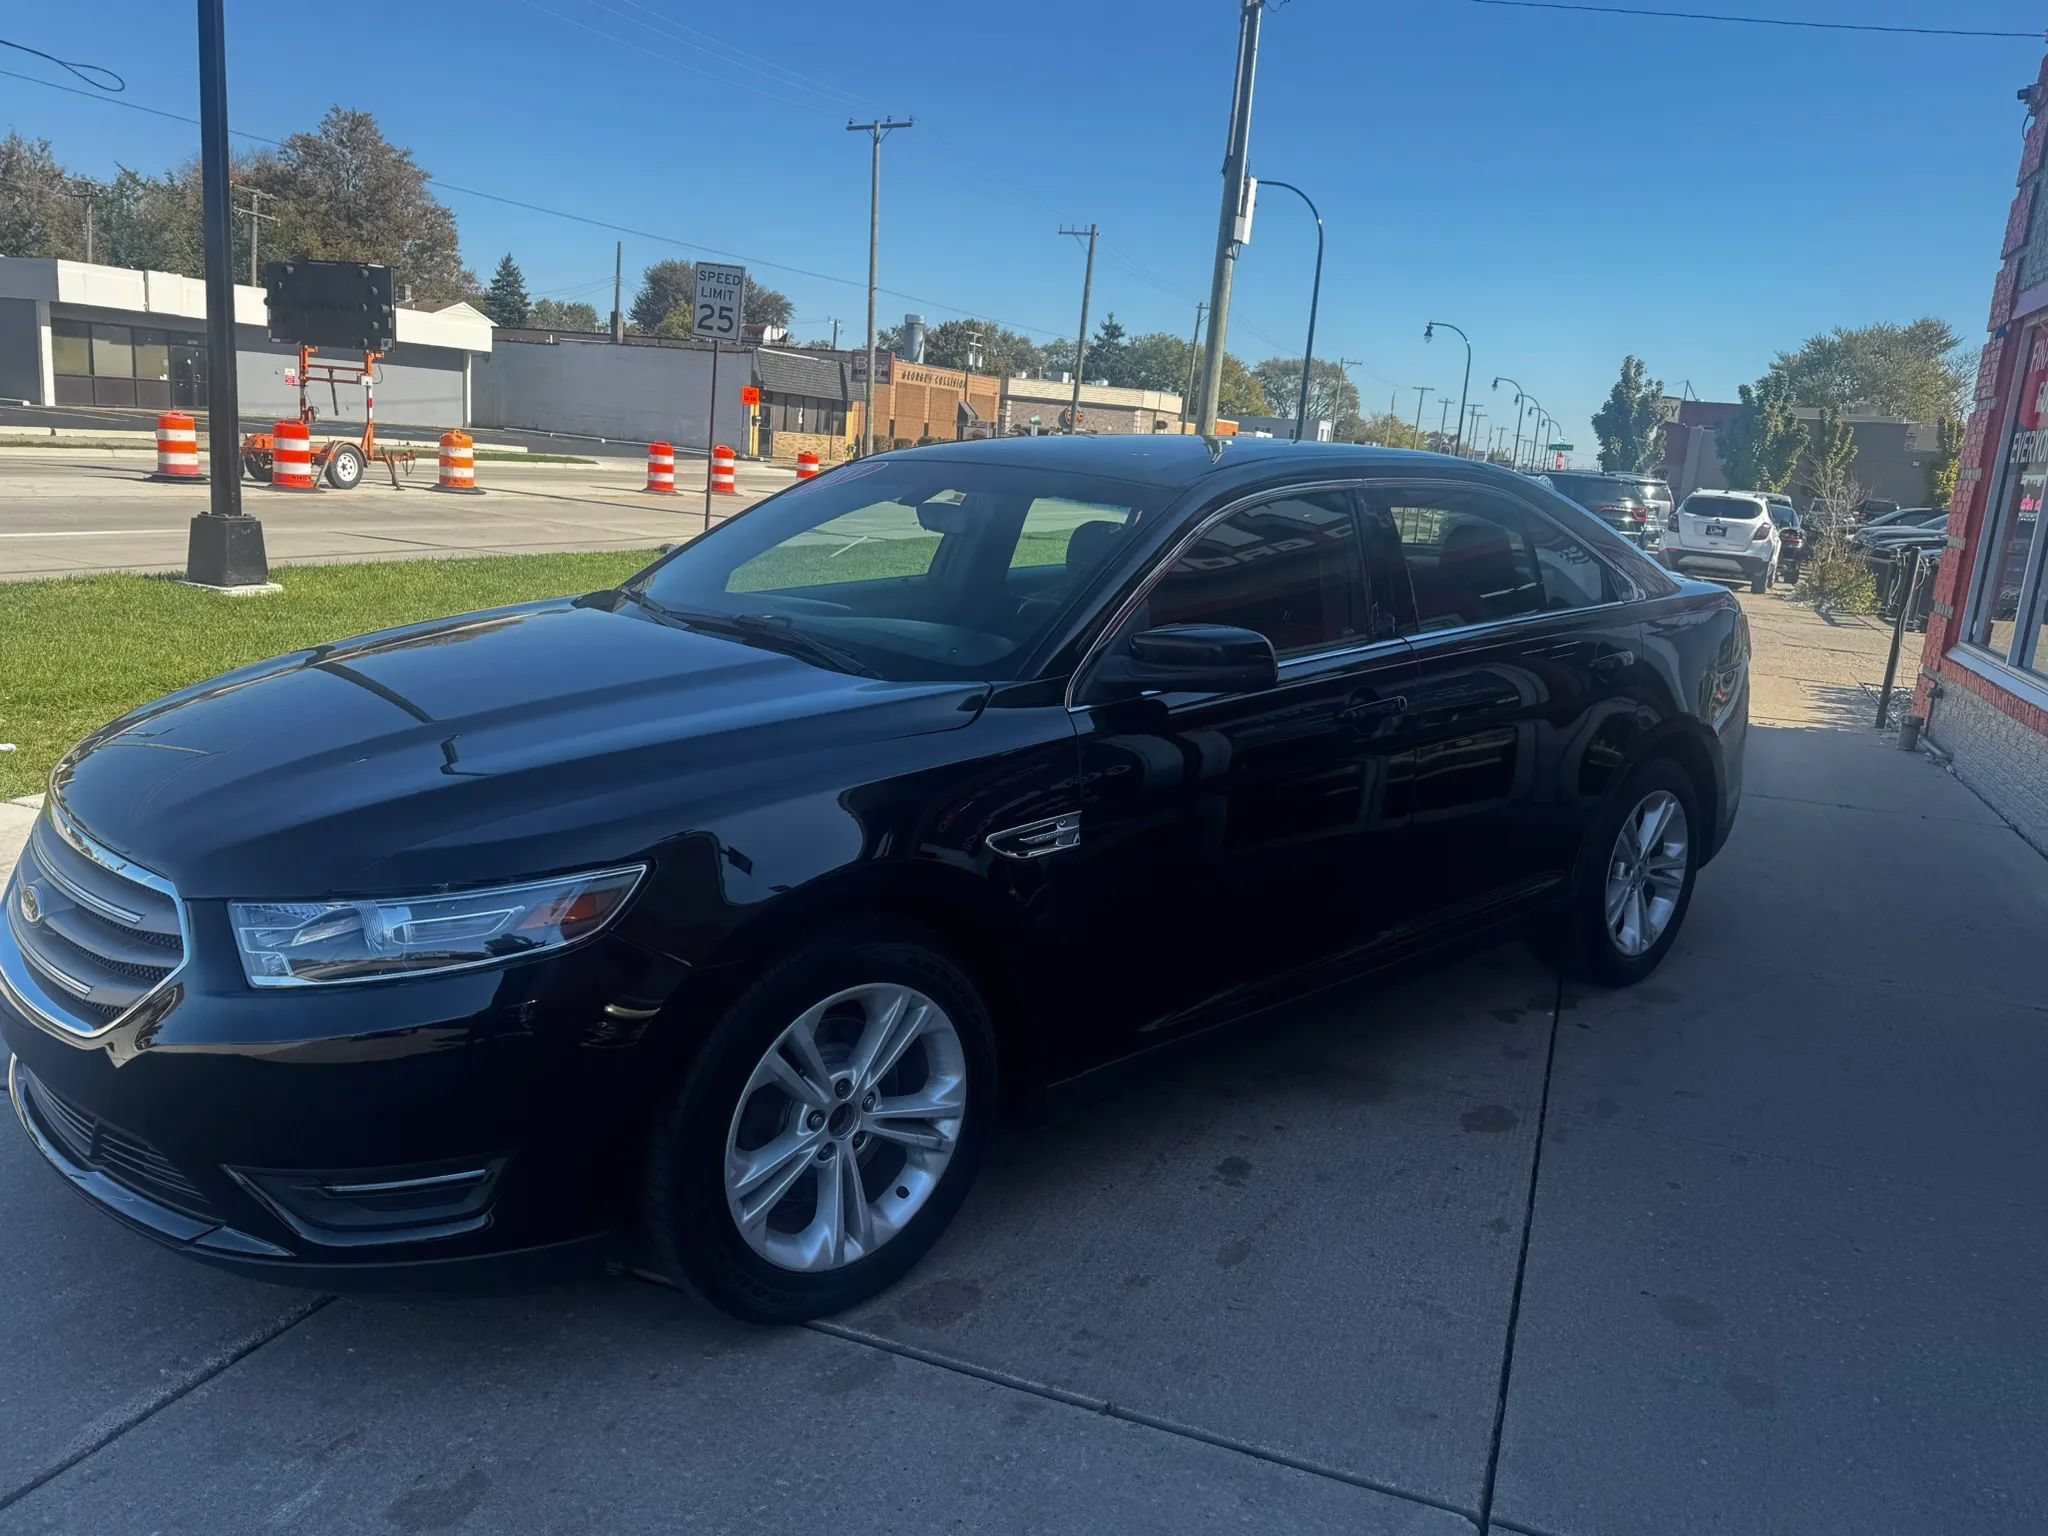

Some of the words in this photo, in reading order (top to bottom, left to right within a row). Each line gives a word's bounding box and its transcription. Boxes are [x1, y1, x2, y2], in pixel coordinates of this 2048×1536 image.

[698, 270, 741, 286] SPEED
[701, 286, 735, 302] LIMIT
[697, 303, 734, 333] 25
